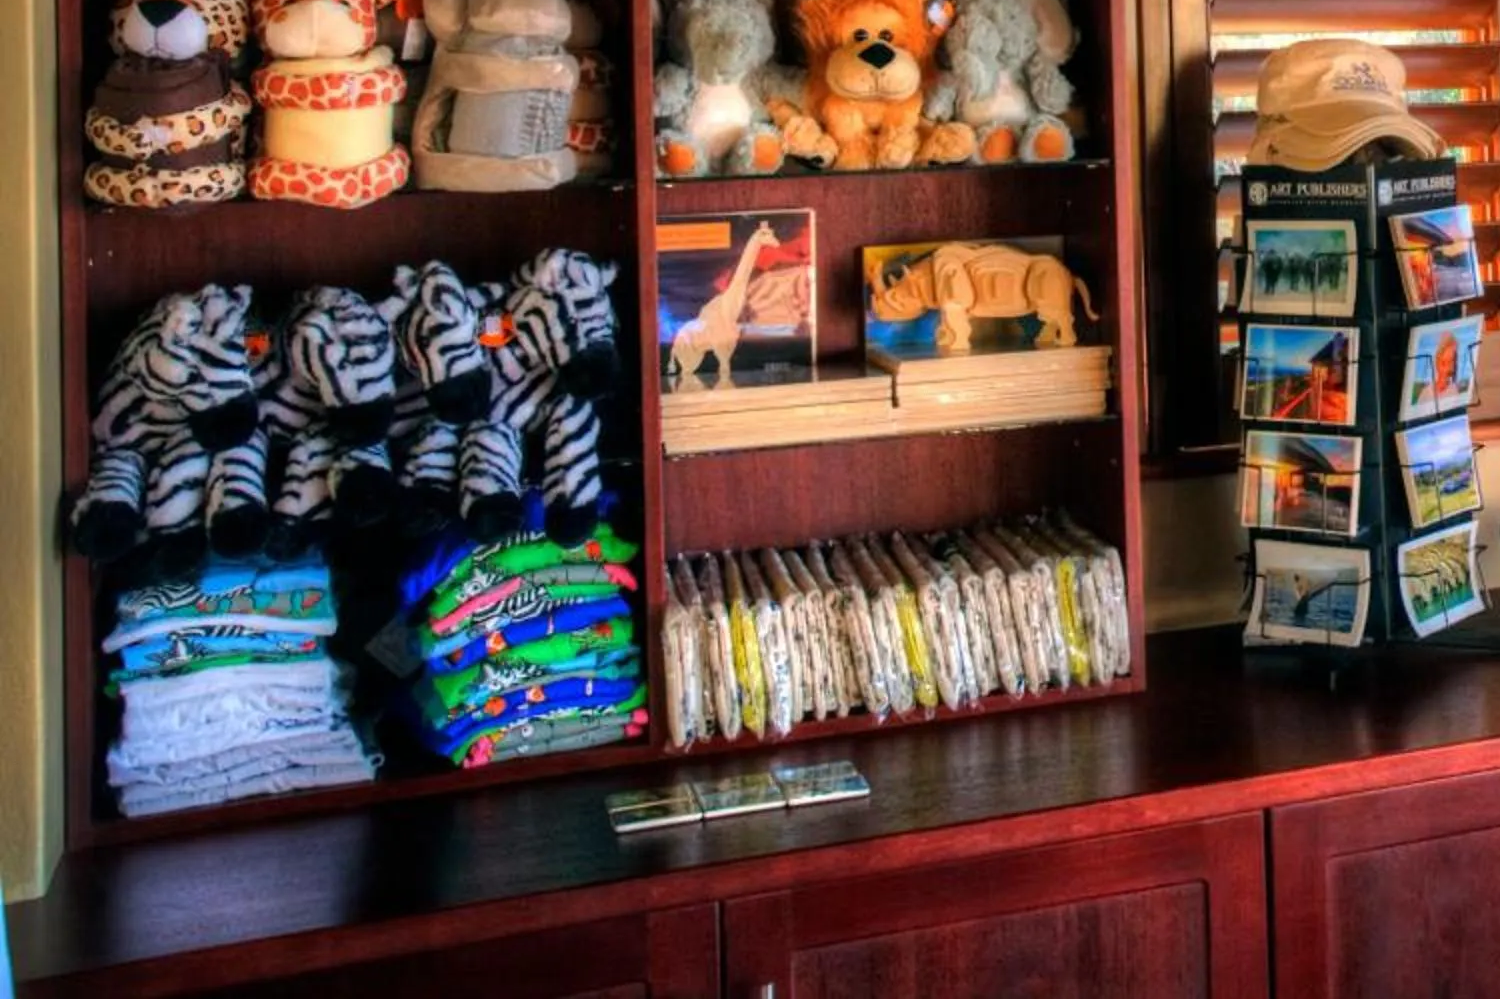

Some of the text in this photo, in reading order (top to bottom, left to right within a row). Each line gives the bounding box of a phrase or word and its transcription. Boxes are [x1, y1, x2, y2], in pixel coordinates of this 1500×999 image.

[1270, 182, 1367, 199] ART PUBLISHERS
[1411, 174, 1456, 192] PUBLISHERS
